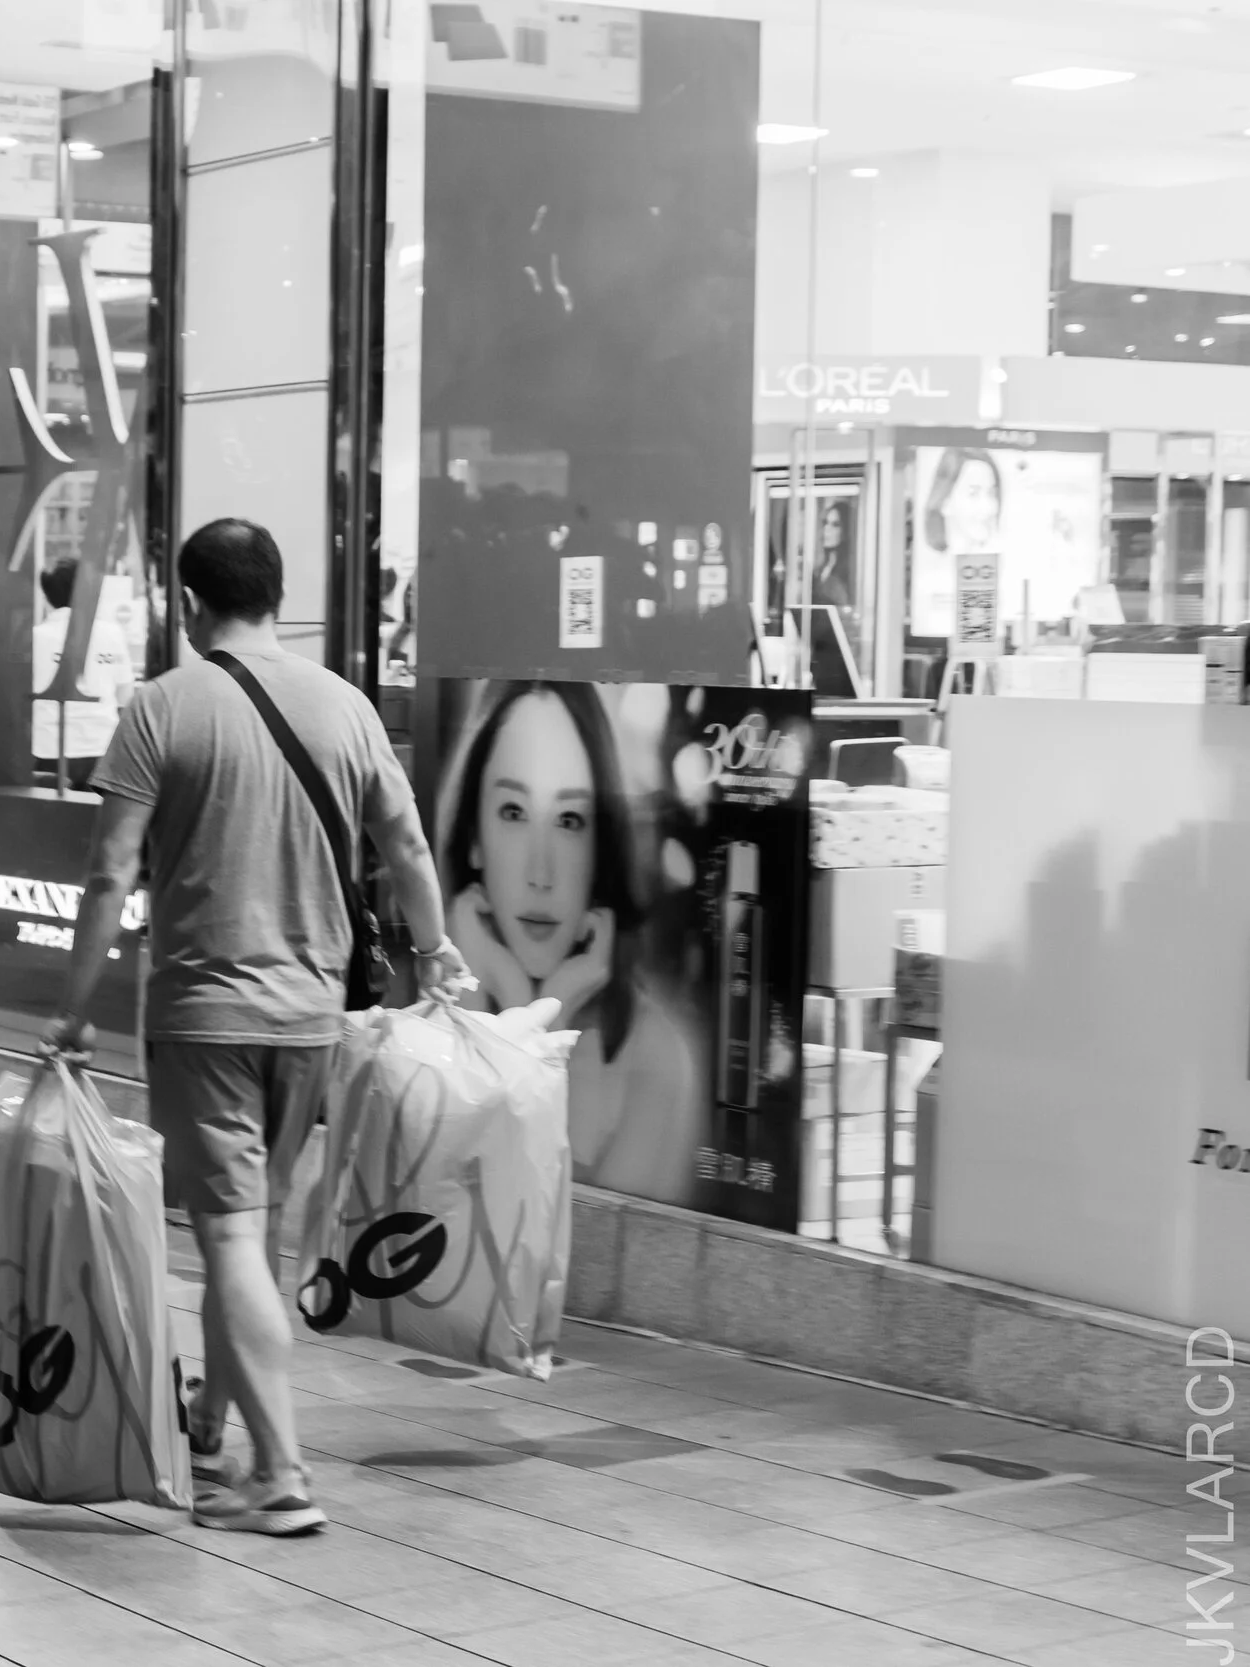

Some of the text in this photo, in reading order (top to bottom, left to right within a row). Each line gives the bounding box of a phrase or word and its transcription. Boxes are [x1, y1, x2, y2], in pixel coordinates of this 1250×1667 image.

[814, 397, 891, 414] PARIS
[569, 567, 594, 581] OG
[961, 564, 996, 580] OG
